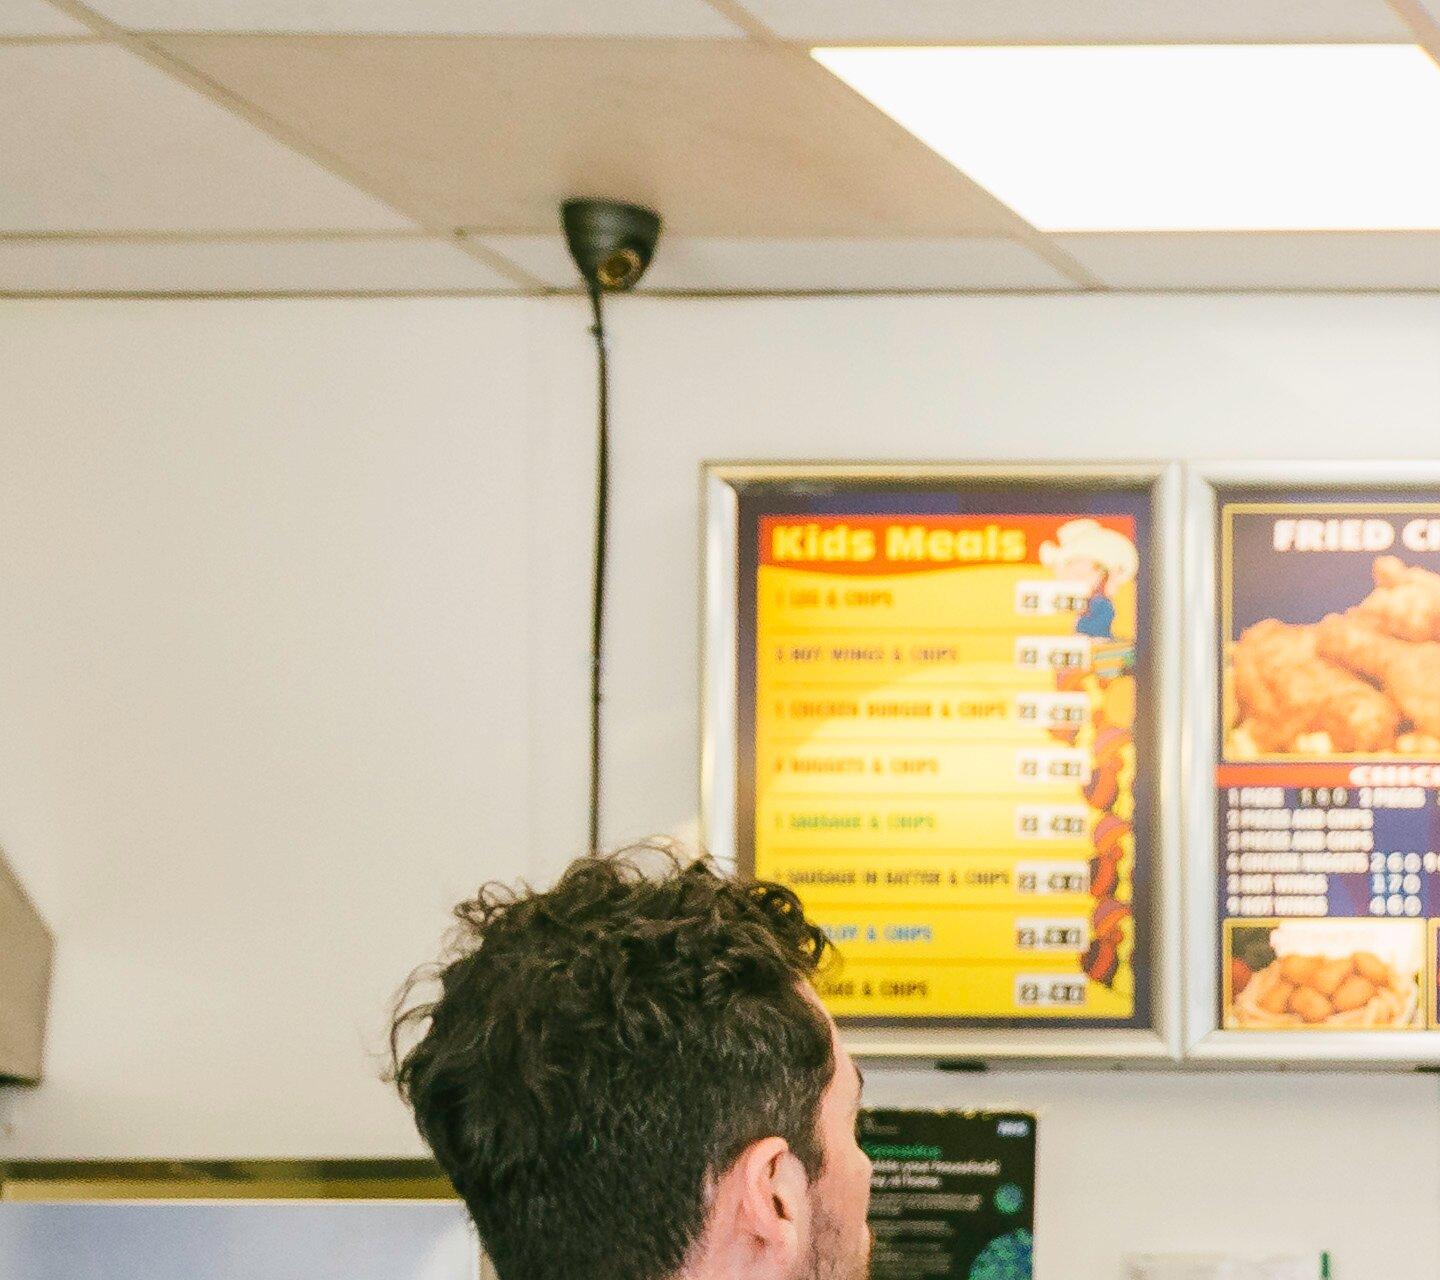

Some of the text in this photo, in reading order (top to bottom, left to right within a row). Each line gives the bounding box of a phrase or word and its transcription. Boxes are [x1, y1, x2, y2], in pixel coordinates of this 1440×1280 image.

[772, 524, 1026, 561] Kids Meals
[1274, 519, 1395, 551] FRIED
